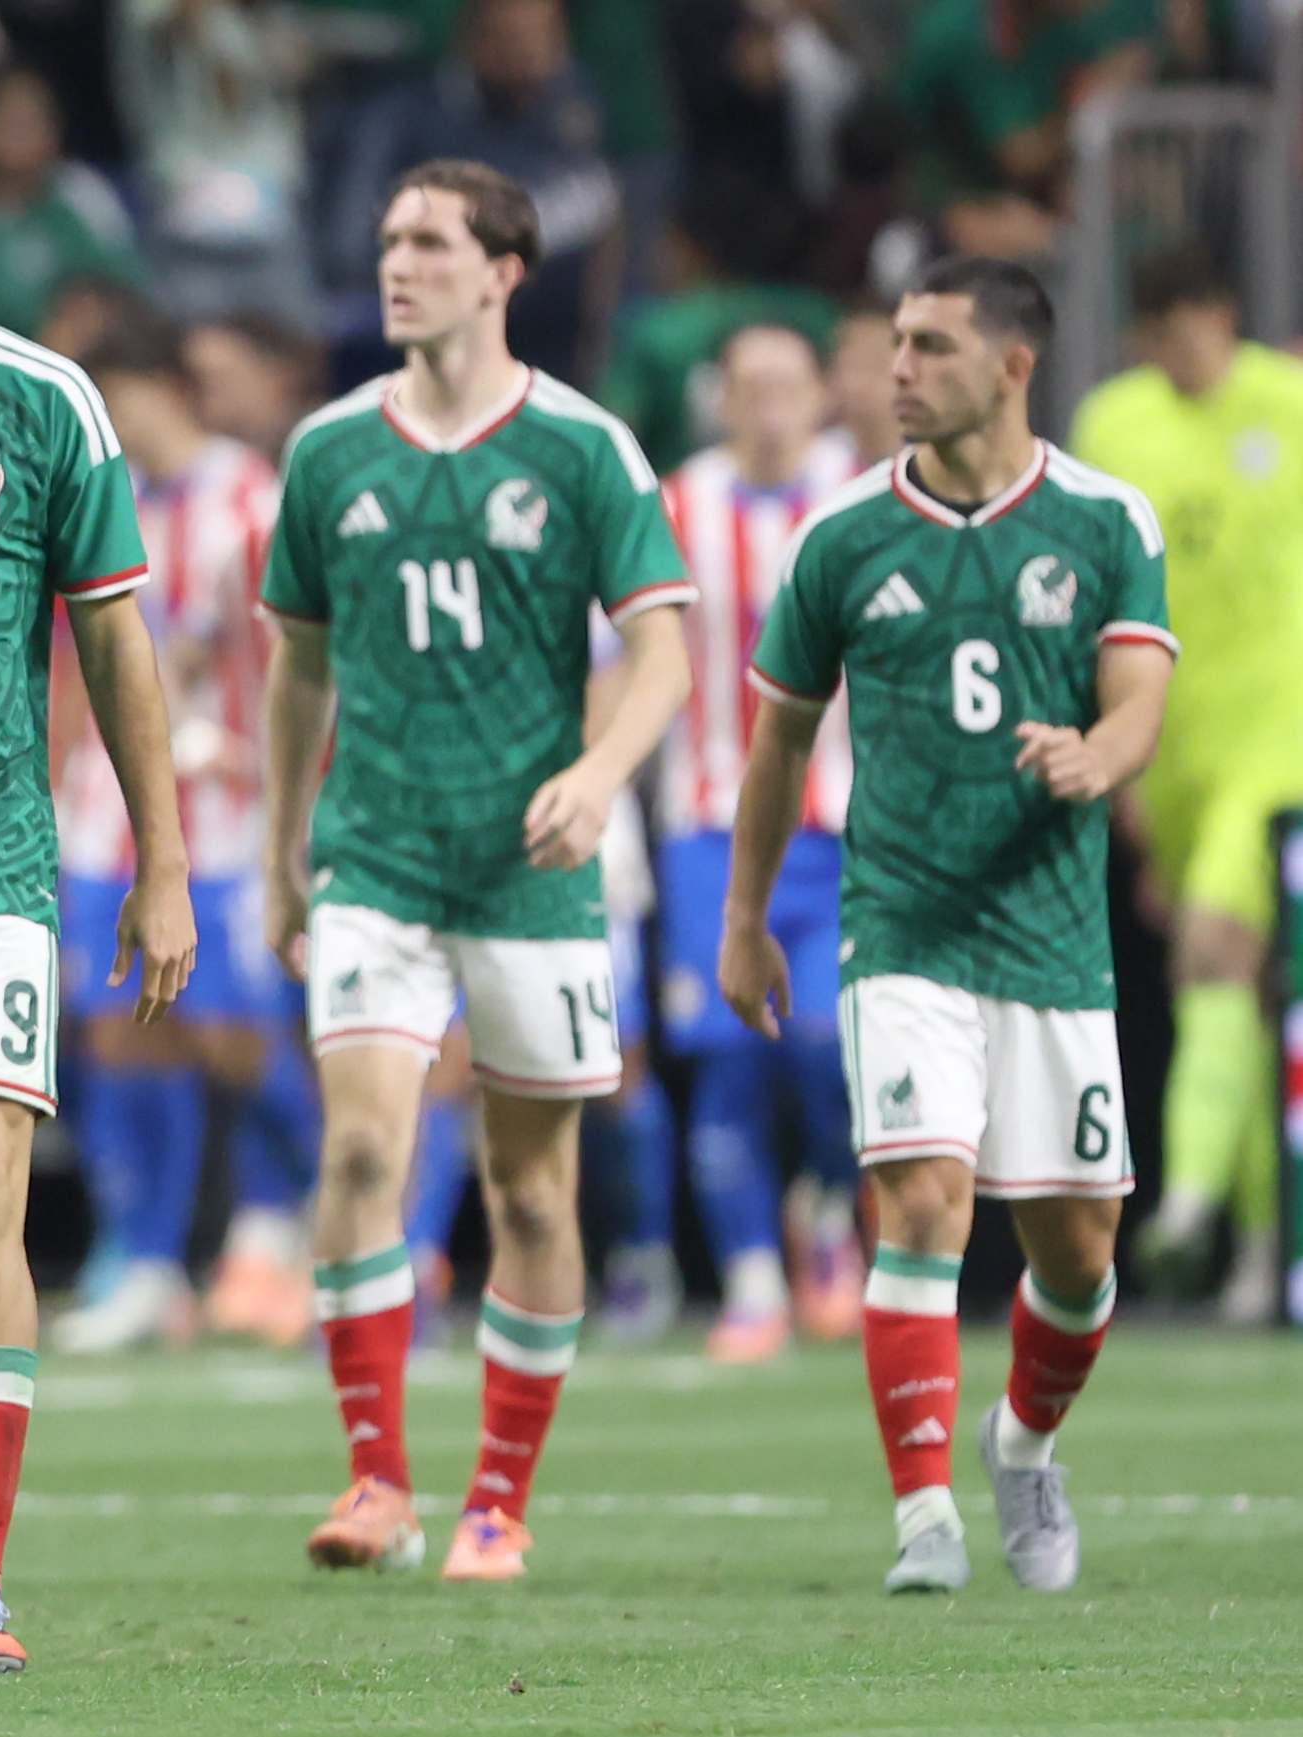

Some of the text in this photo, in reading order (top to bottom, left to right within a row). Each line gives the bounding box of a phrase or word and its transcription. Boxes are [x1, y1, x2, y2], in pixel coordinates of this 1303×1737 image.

[399, 559, 483, 651] 14
[951, 639, 1002, 733] 6
[0, 980, 39, 1066] 9
[1072, 1083, 1111, 1165] 6
